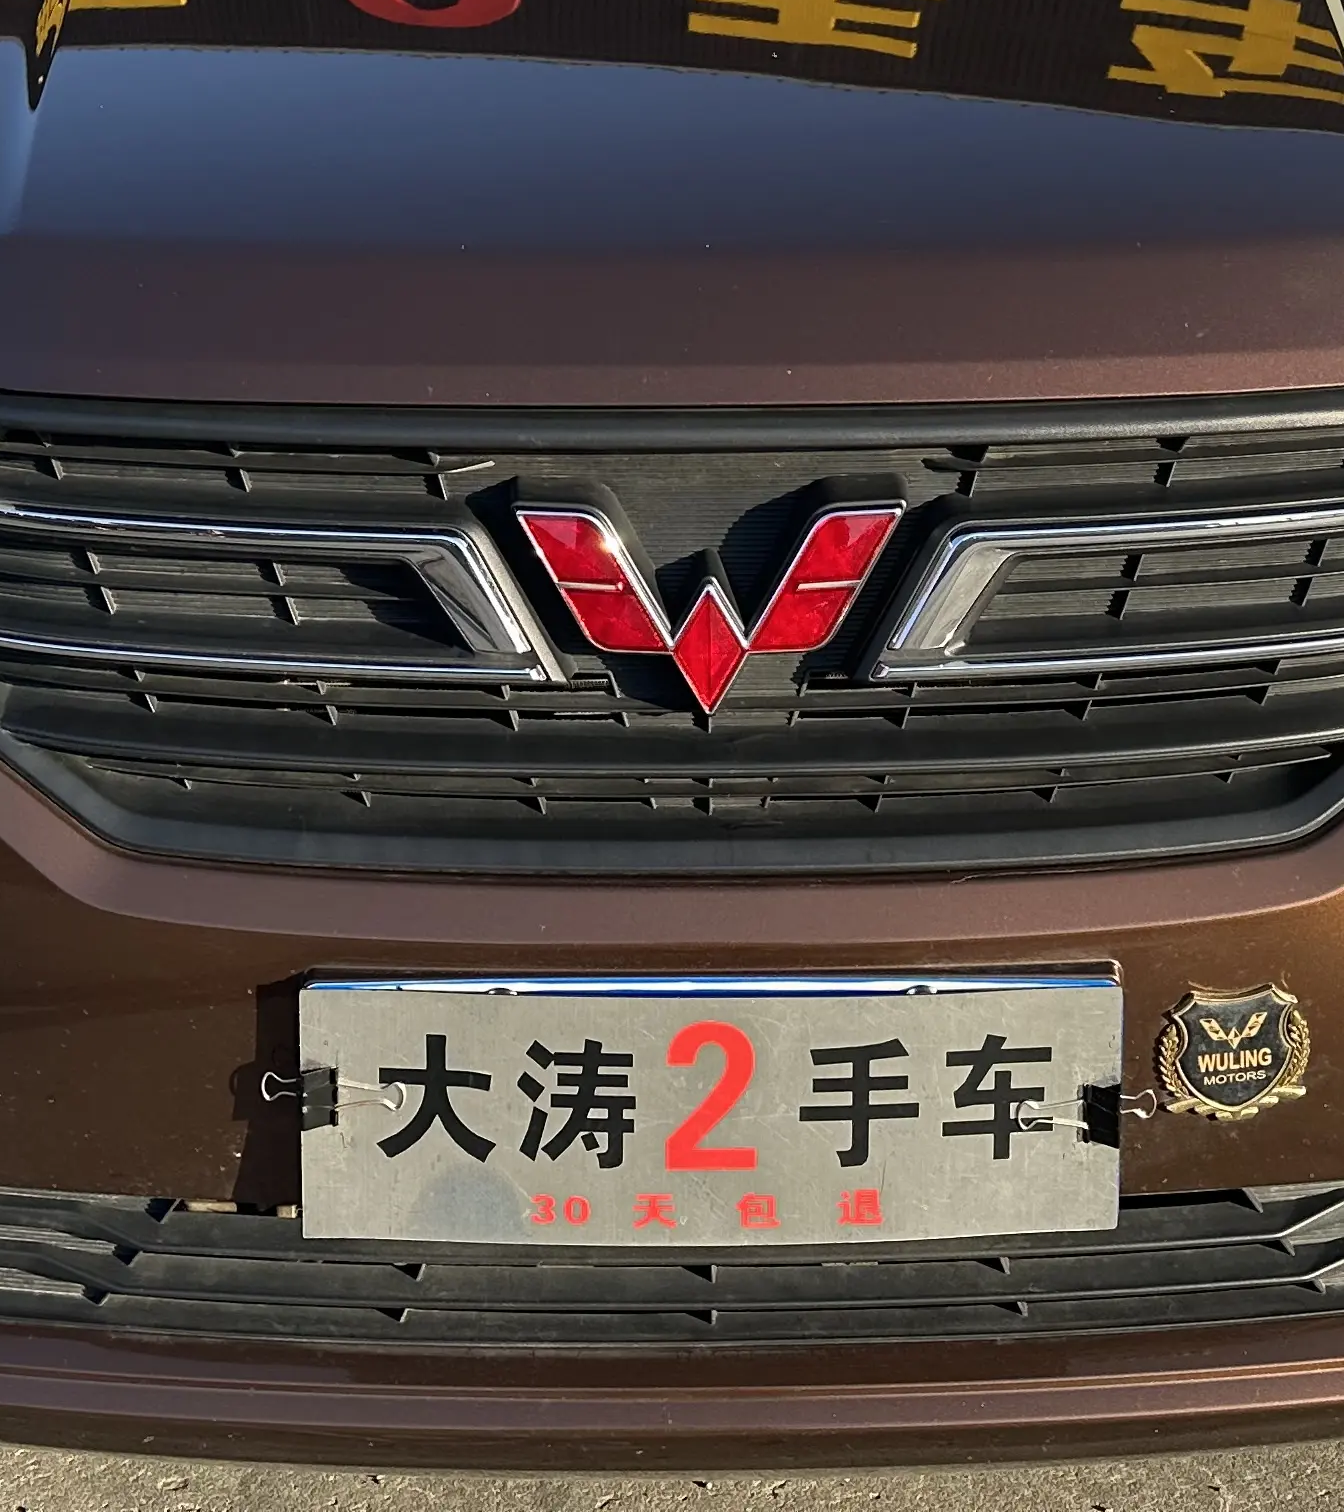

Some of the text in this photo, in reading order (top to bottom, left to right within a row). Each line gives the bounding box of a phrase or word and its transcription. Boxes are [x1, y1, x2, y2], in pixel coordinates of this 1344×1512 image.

[1197, 1046, 1273, 1074] WULING
[1202, 1069, 1267, 1087] MOTORS
[377, 1019, 1054, 1173] 大涛2手车
[531, 1190, 884, 1230] 30天包退
